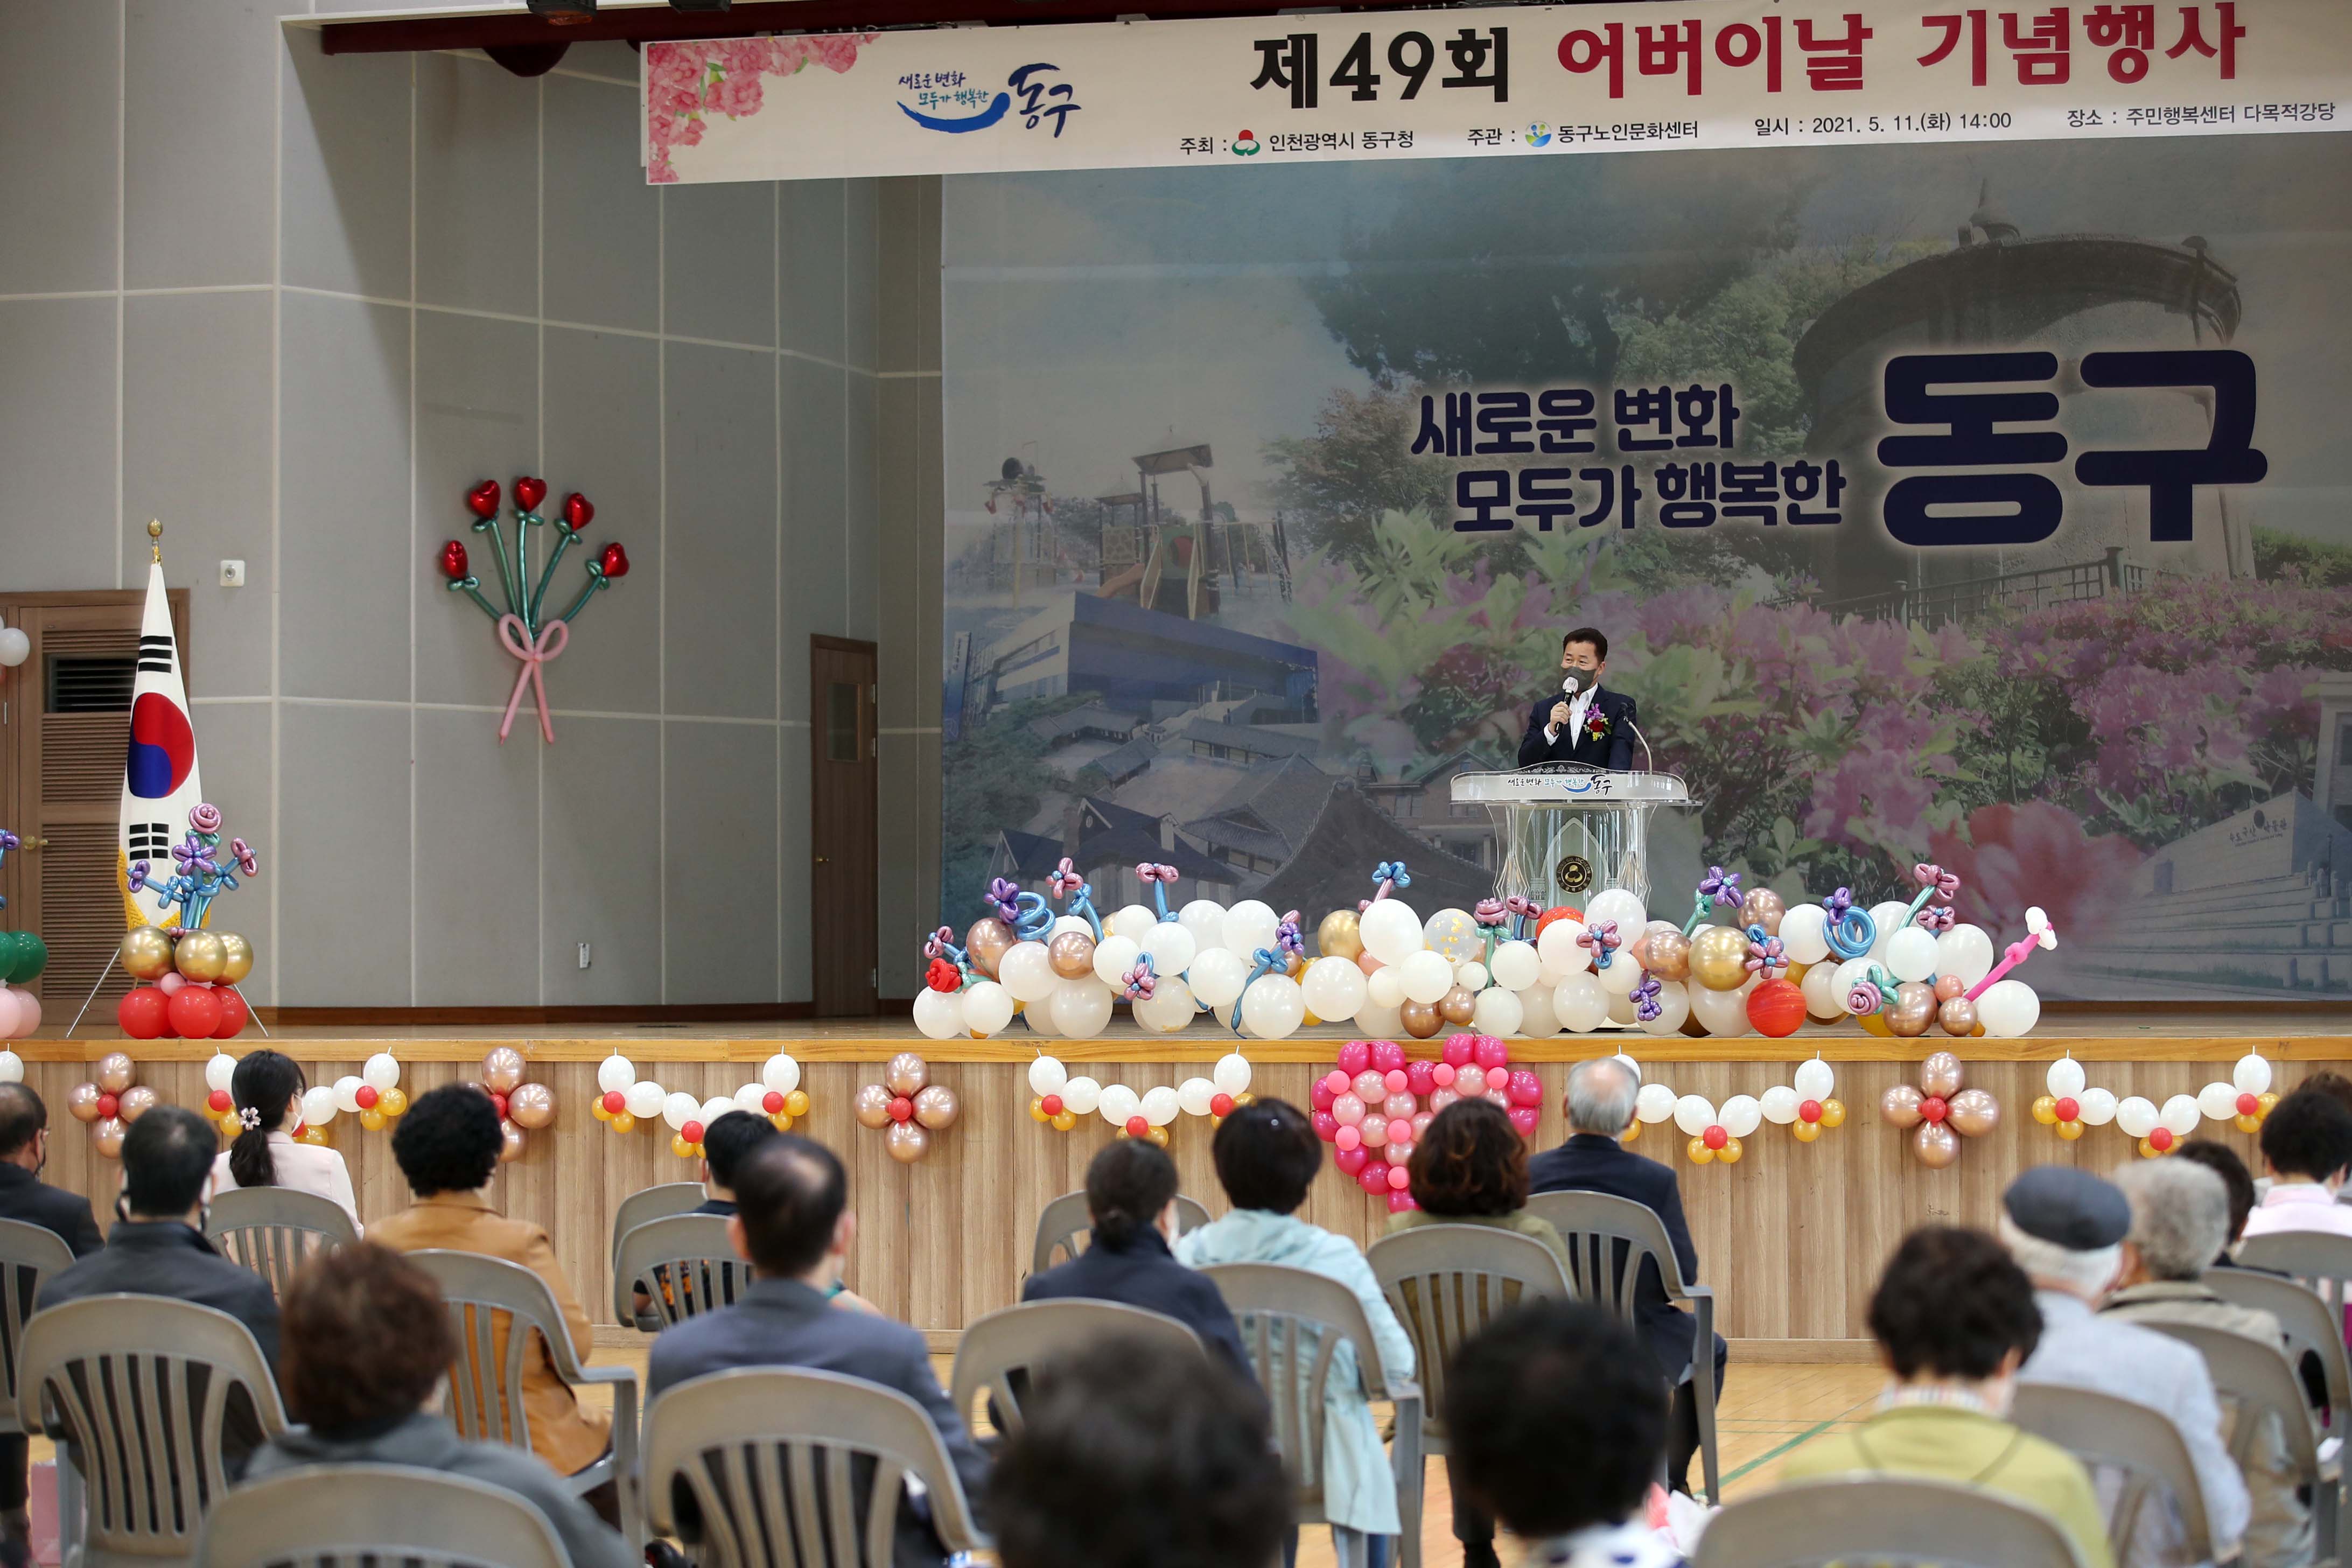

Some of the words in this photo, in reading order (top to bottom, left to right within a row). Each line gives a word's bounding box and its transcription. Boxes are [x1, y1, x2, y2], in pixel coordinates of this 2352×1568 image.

[1250, 26, 1508, 109] 제49회
[1557, 13, 1873, 99] 어버이날
[1916, 1, 2246, 86] 기념행사
[898, 73, 932, 90] 새로운
[935, 71, 966, 88] 변화
[919, 92, 951, 110] 모두가
[954, 88, 989, 109] 행복한
[1007, 62, 1082, 138] 동구
[1755, 117, 1788, 136] 일시
[1812, 117, 1860, 133] 2021.
[1868, 116, 1885, 133] 5.
[1960, 112, 2011, 129] 14:00
[2067, 109, 2103, 128] 장소
[2126, 105, 2235, 126] 주민행복센터
[2244, 102, 2336, 122] 다목적강당
[1180, 137, 1213, 155] 주최
[1269, 131, 1354, 152] 인천광역시
[1362, 130, 1413, 149] 동구청
[1467, 128, 1503, 146] 주관
[1558, 120, 1698, 143] 동구노인문화센터
[1410, 389, 1597, 457] 새로운
[1614, 383, 1740, 452] 변화
[1877, 349, 2268, 547] 동구
[1453, 464, 1642, 532] 모두가
[1654, 459, 1847, 528] 행복한
[1508, 778, 1525, 787] 새로운
[1526, 778, 1542, 786] 변화
[1544, 778, 1562, 788] 모두가
[1564, 778, 1584, 787] 행복한
[1590, 774, 1613, 796] 동구
